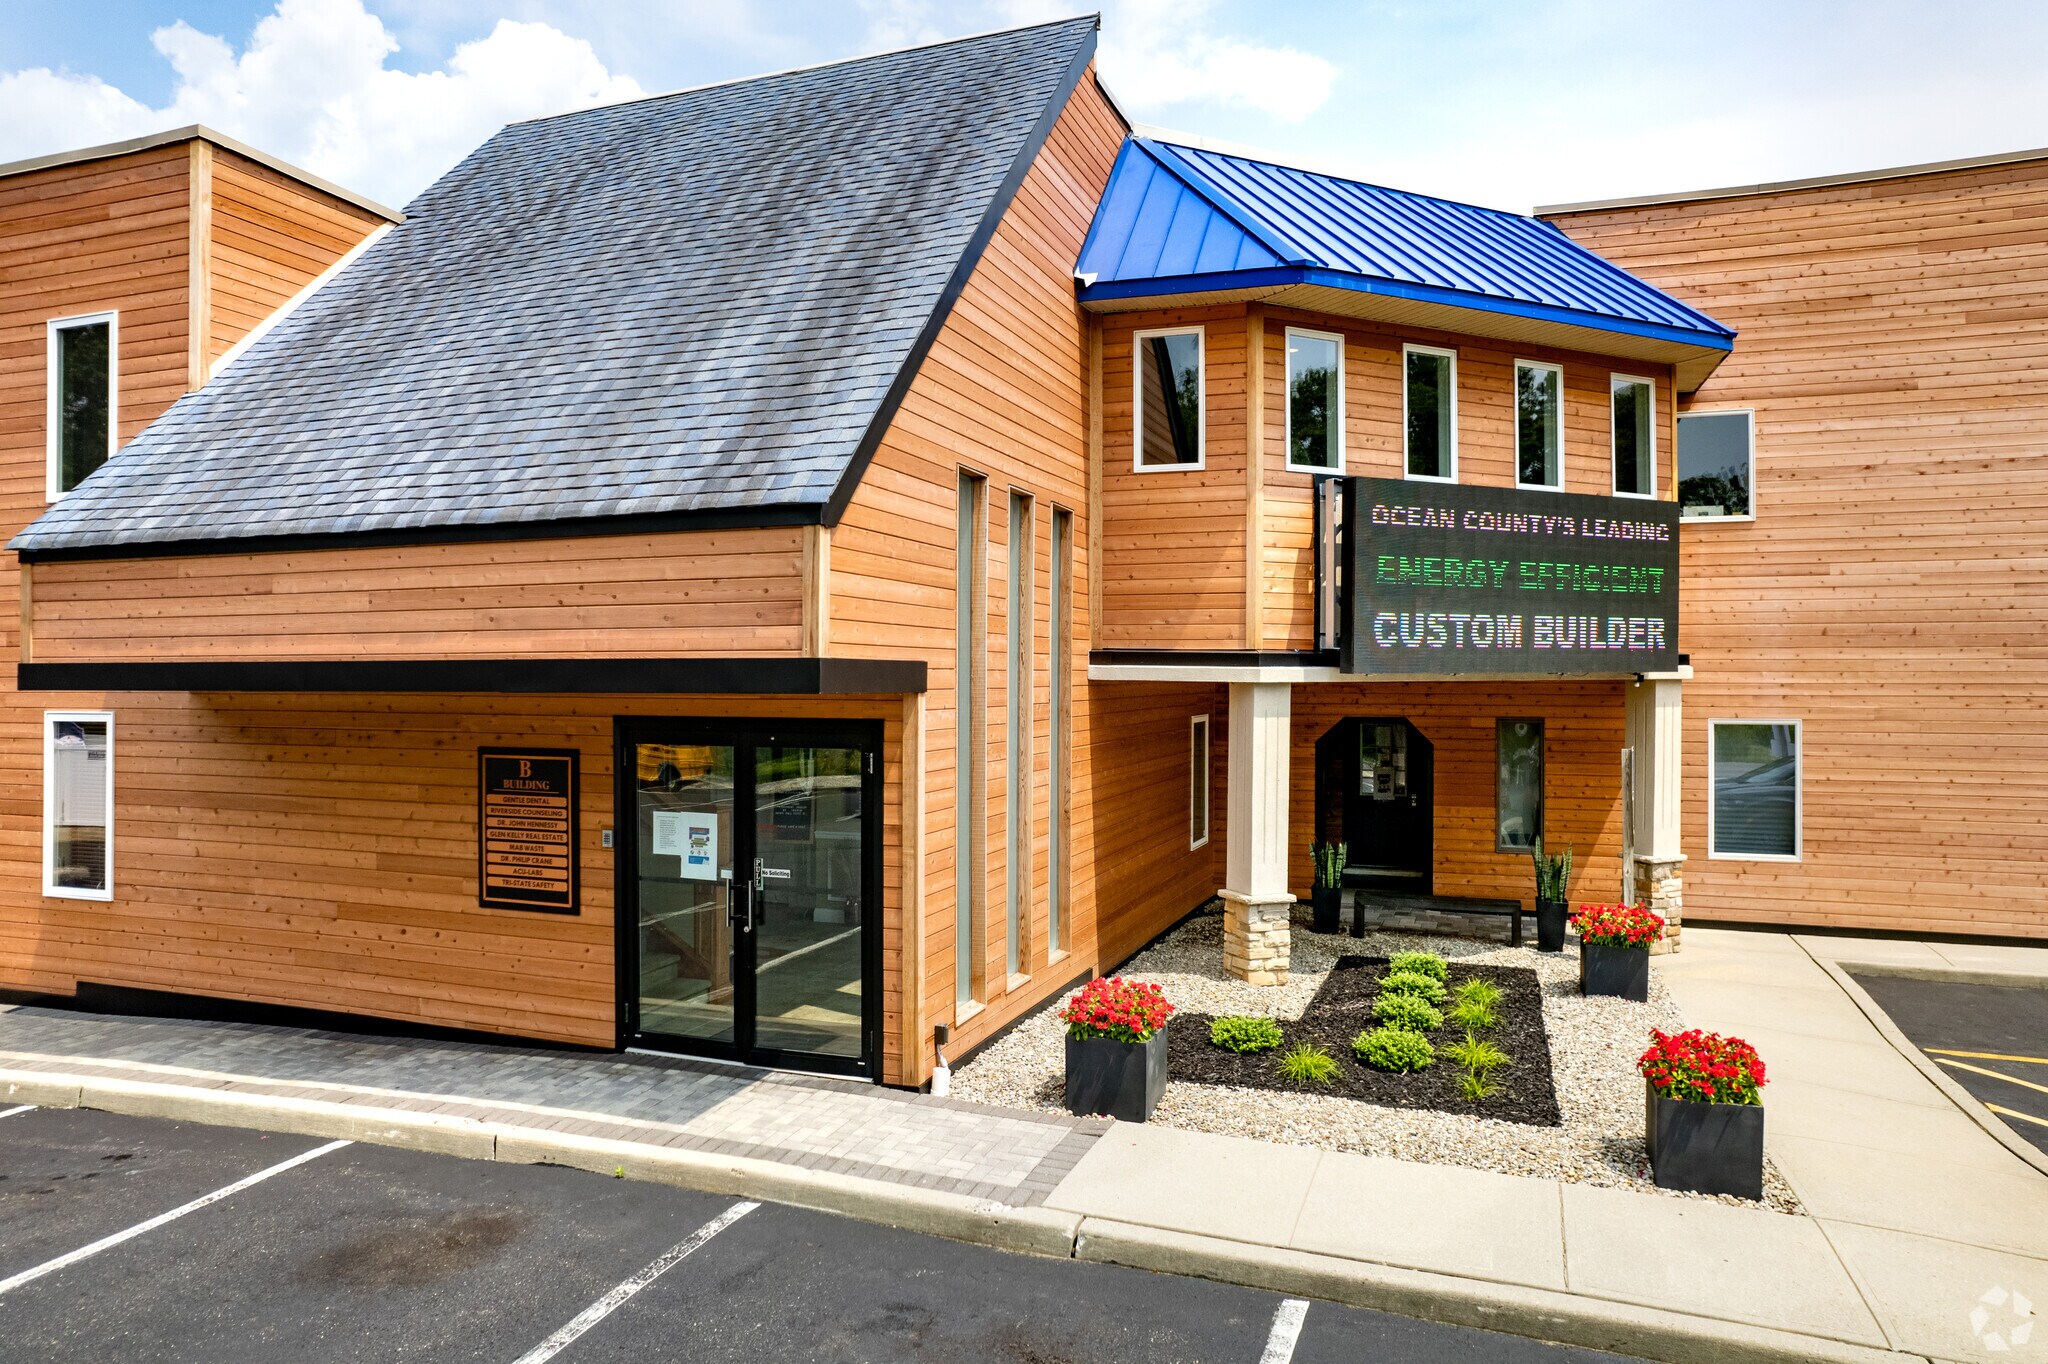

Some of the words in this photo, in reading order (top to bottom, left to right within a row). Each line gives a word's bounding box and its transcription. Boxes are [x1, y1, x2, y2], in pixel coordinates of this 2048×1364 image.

[1372, 505, 1455, 528] OCEAN
[1463, 510, 1575, 535] COUNTY'S
[1582, 518, 1670, 541] LEADING
[1376, 555, 1510, 589] ENERGY
[1519, 562, 1664, 593] EFFICIENT
[1374, 612, 1523, 648] CUSTOM
[1534, 615, 1666, 650] BUILDER
[503, 779, 550, 790] BUILDING
[519, 760, 532, 777] B
